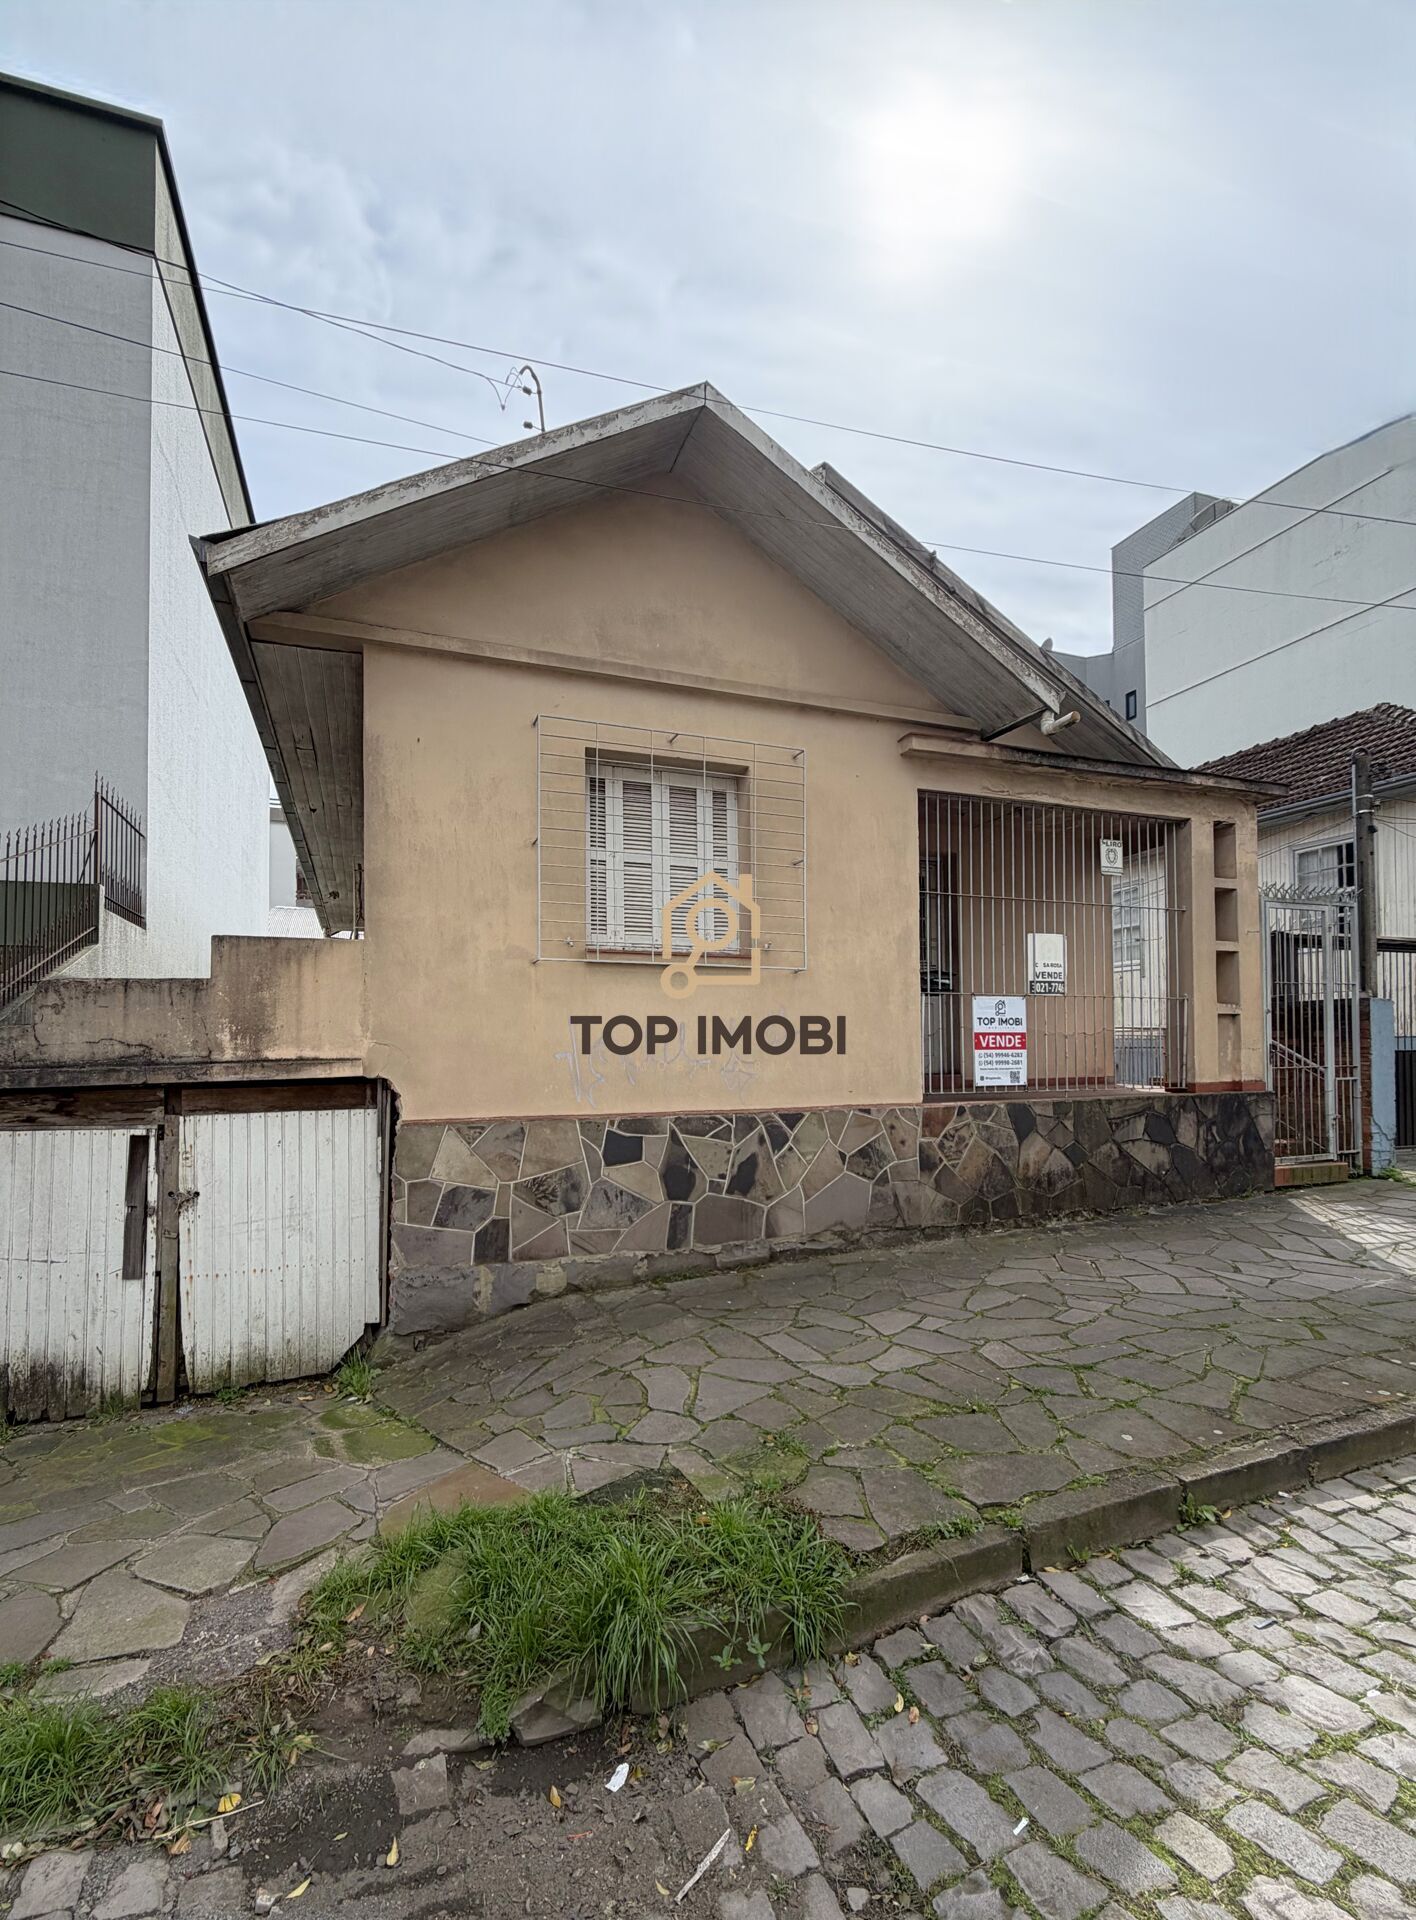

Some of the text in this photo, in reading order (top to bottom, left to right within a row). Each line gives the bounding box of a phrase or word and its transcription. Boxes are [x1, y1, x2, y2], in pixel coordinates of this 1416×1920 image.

[1035, 971, 1063, 980] VENDE
[976, 1017, 1023, 1026] TOP IMOBI
[979, 1035, 1022, 1047] VENDE
